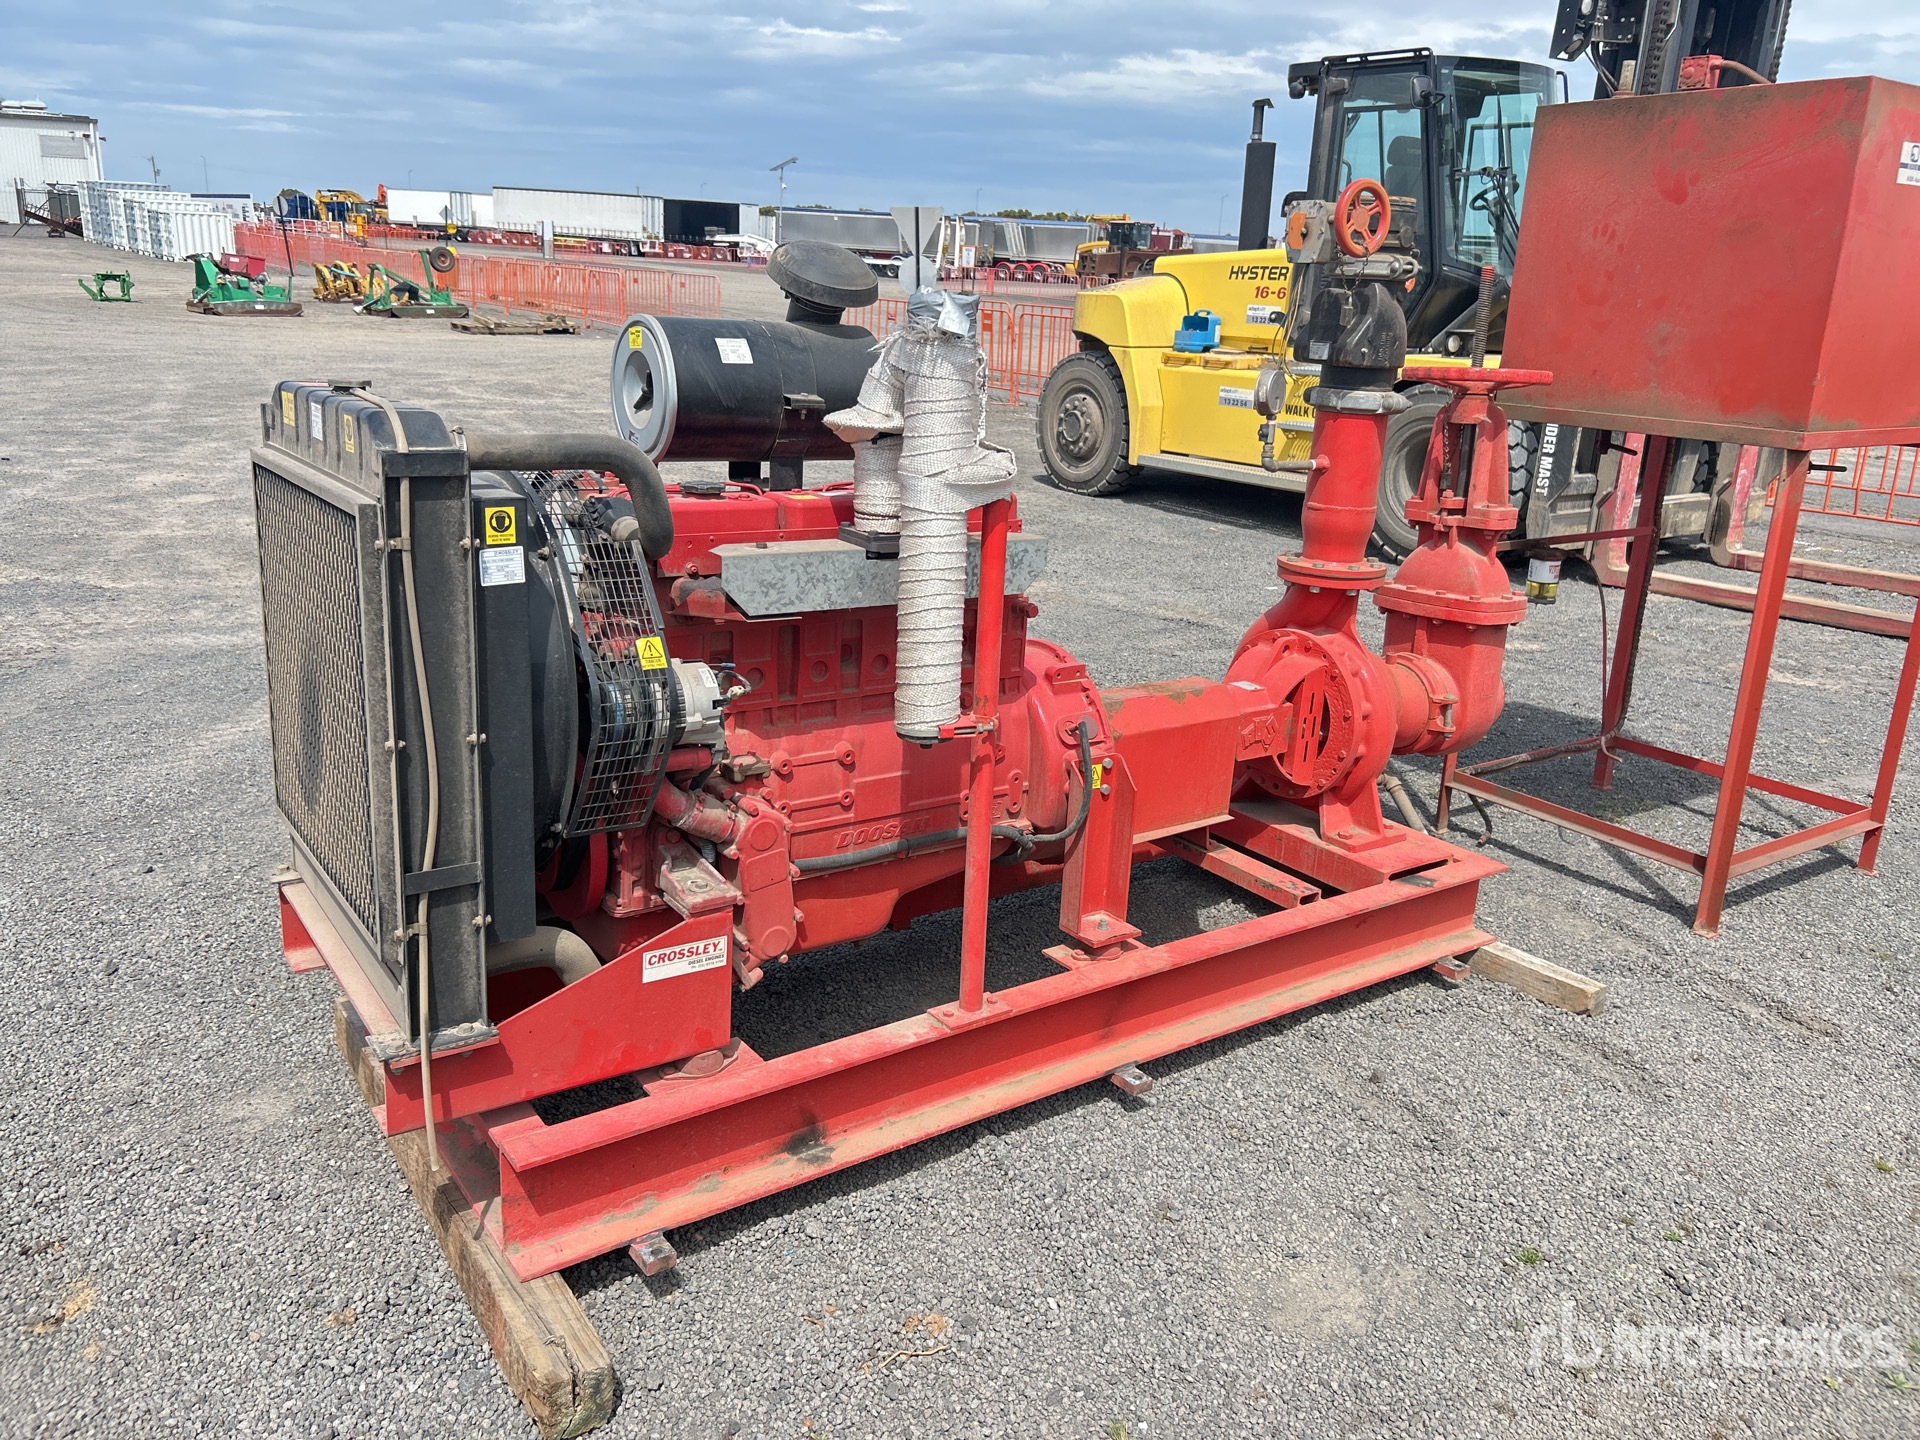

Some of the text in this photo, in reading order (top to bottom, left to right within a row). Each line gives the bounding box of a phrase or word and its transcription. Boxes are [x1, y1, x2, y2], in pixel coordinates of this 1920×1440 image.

[1229, 265, 1290, 281] HYSTER
[1254, 286, 1287, 299] 16-6
[1285, 404, 1310, 417] WALK
[1536, 456, 1553, 496] MAST
[648, 941, 721, 966] CROSSLEY
[705, 954, 725, 962] ENGINES
